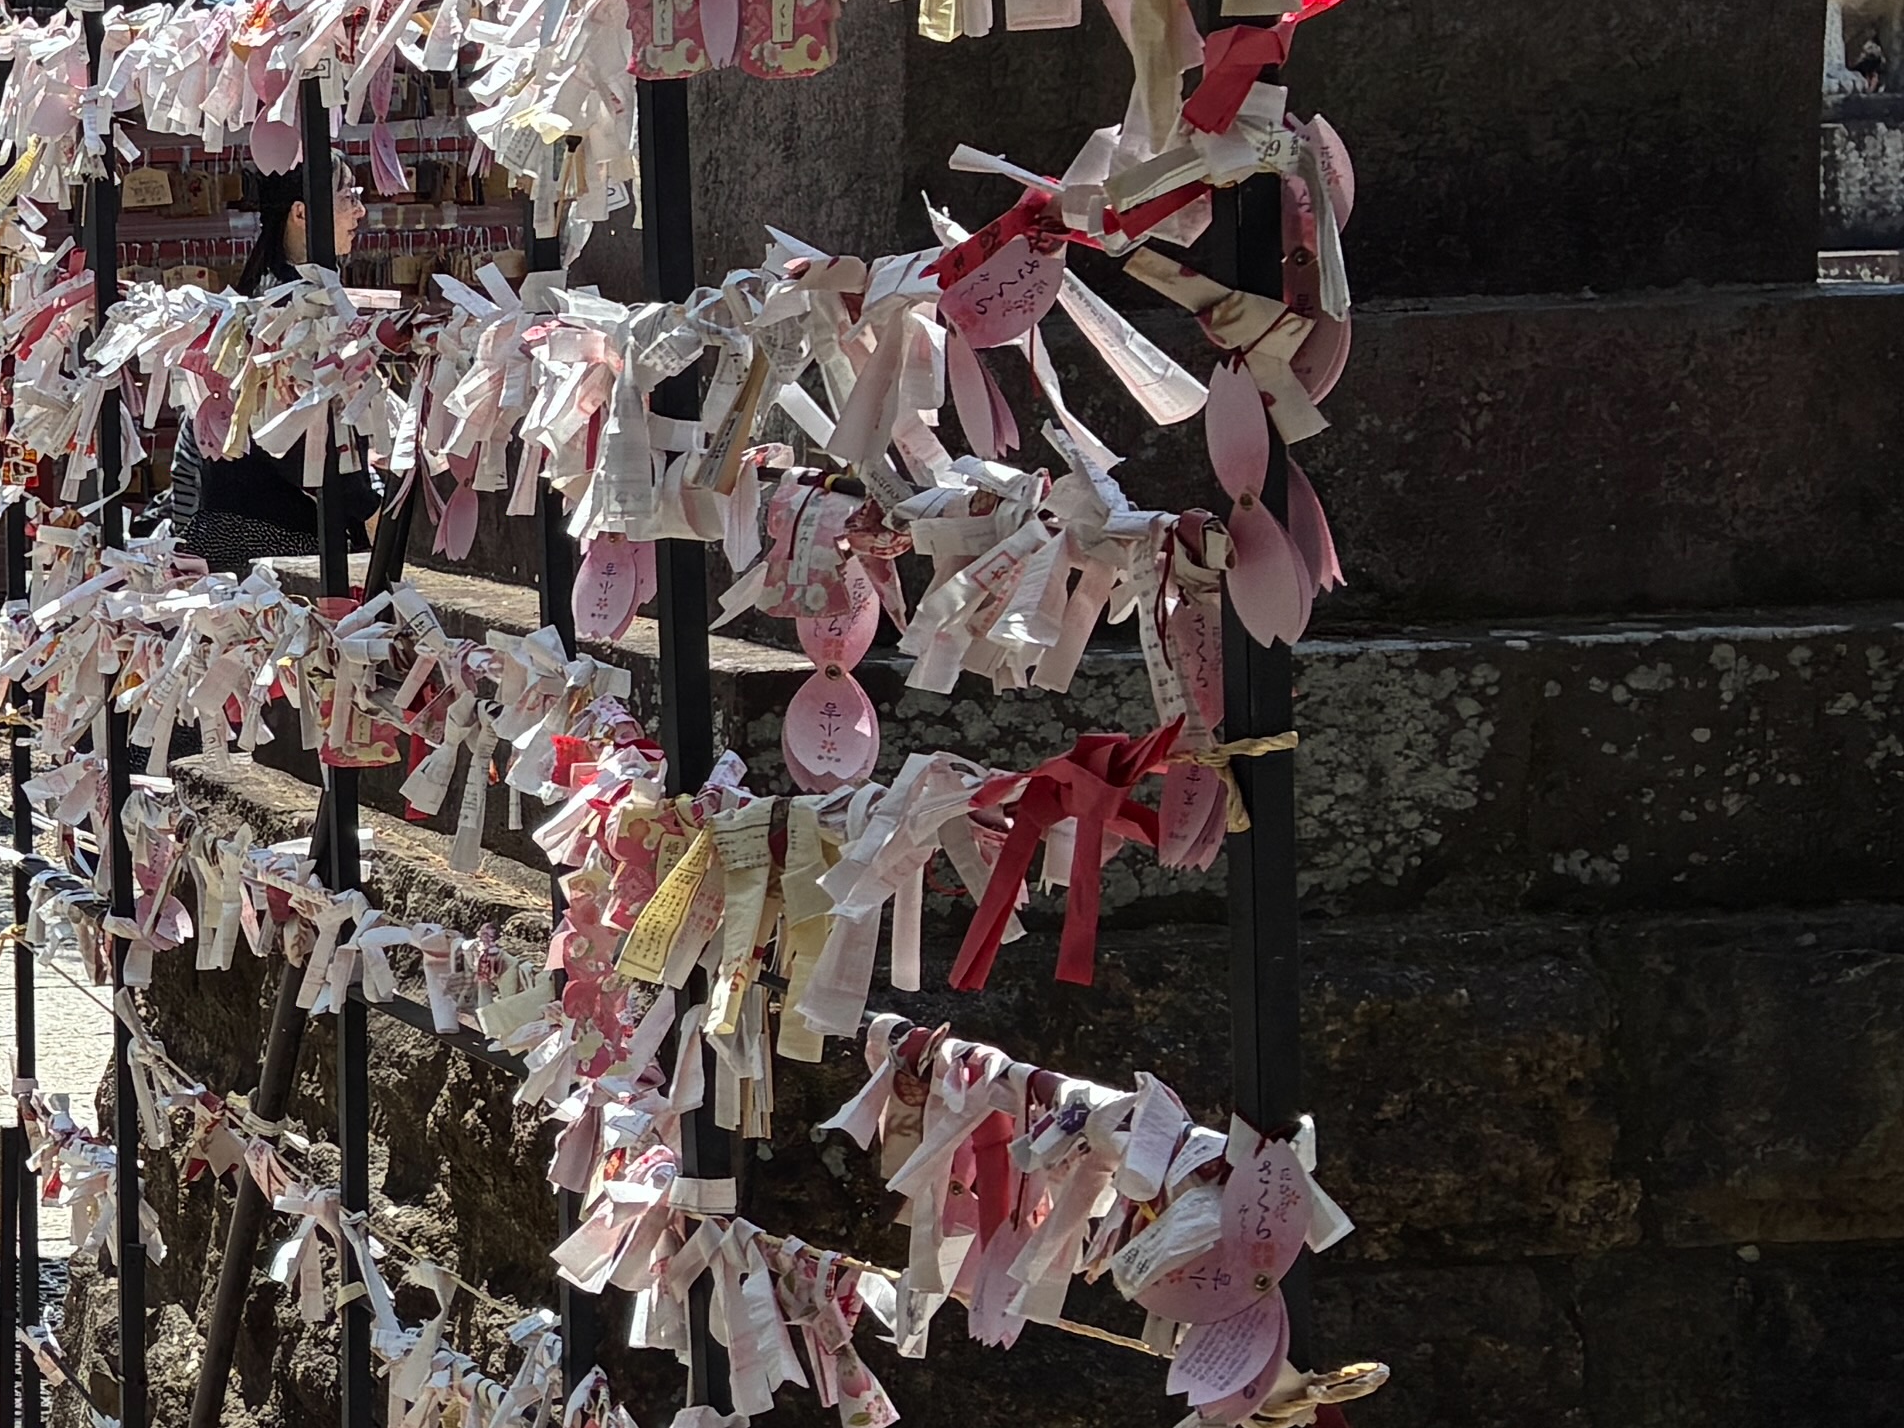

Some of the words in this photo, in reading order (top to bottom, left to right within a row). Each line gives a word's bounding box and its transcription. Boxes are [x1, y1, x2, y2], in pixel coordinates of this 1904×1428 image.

[975, 259, 1040, 316] さくら
[1192, 612, 1209, 689] さくら
[1256, 1160, 1272, 1240] さくら
